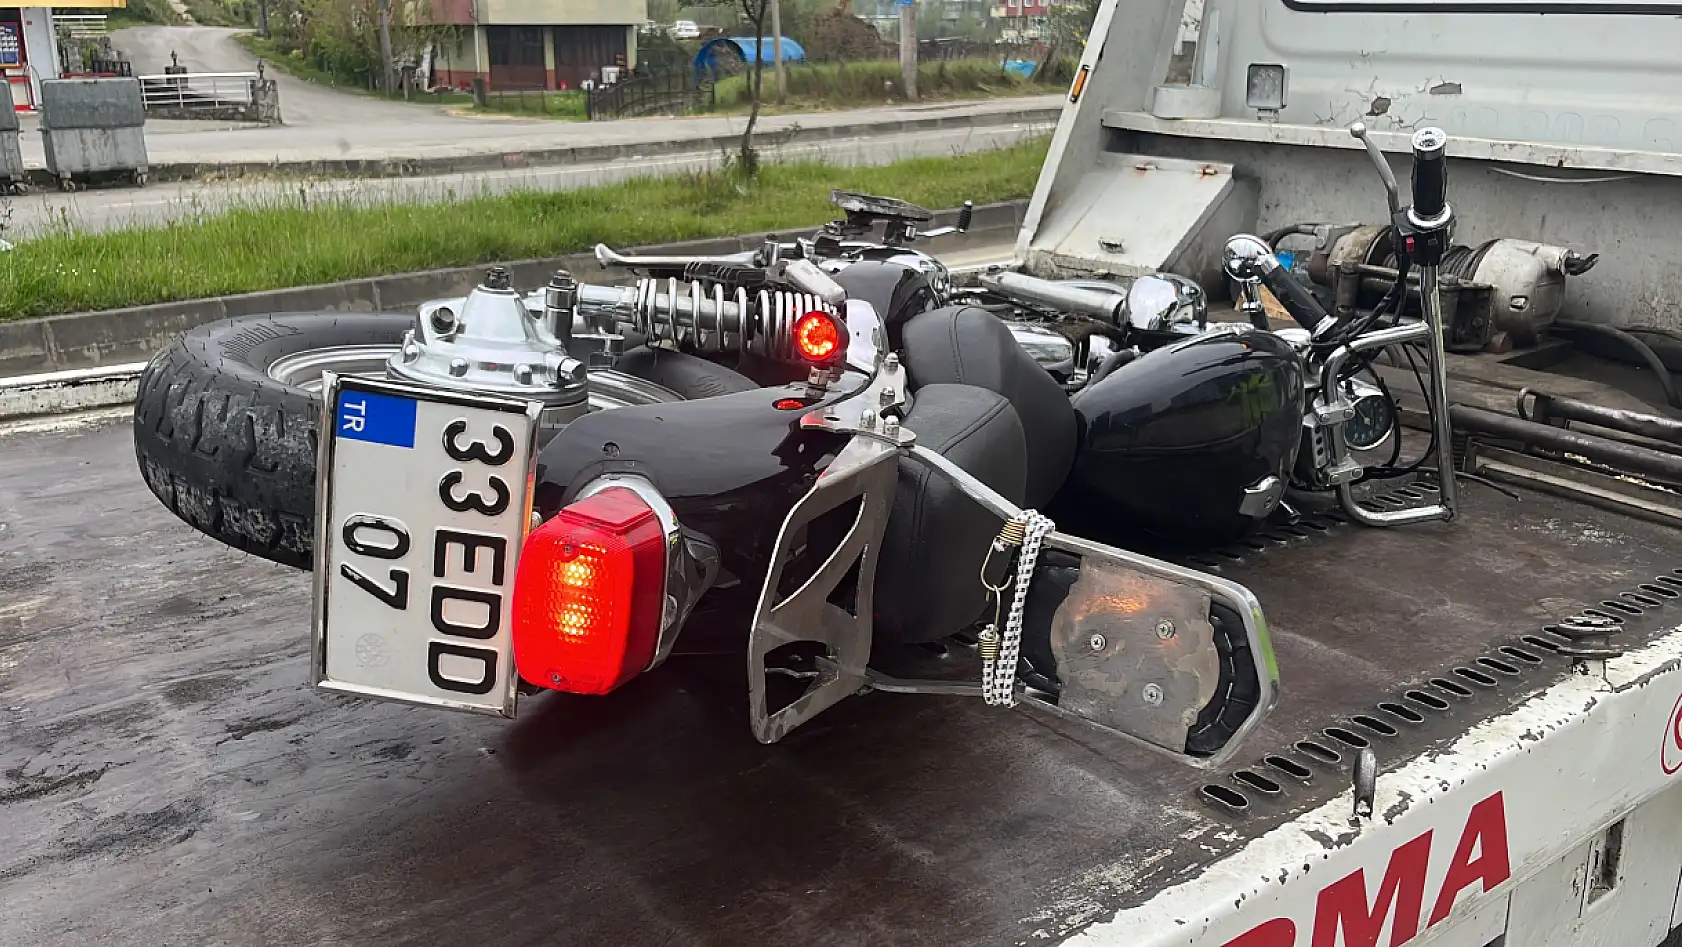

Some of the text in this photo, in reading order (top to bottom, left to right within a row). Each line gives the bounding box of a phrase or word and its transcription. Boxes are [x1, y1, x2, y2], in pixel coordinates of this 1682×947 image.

[343, 400, 366, 432] TR
[341, 514, 411, 611] 07
[428, 420, 515, 695] 33 EDD
